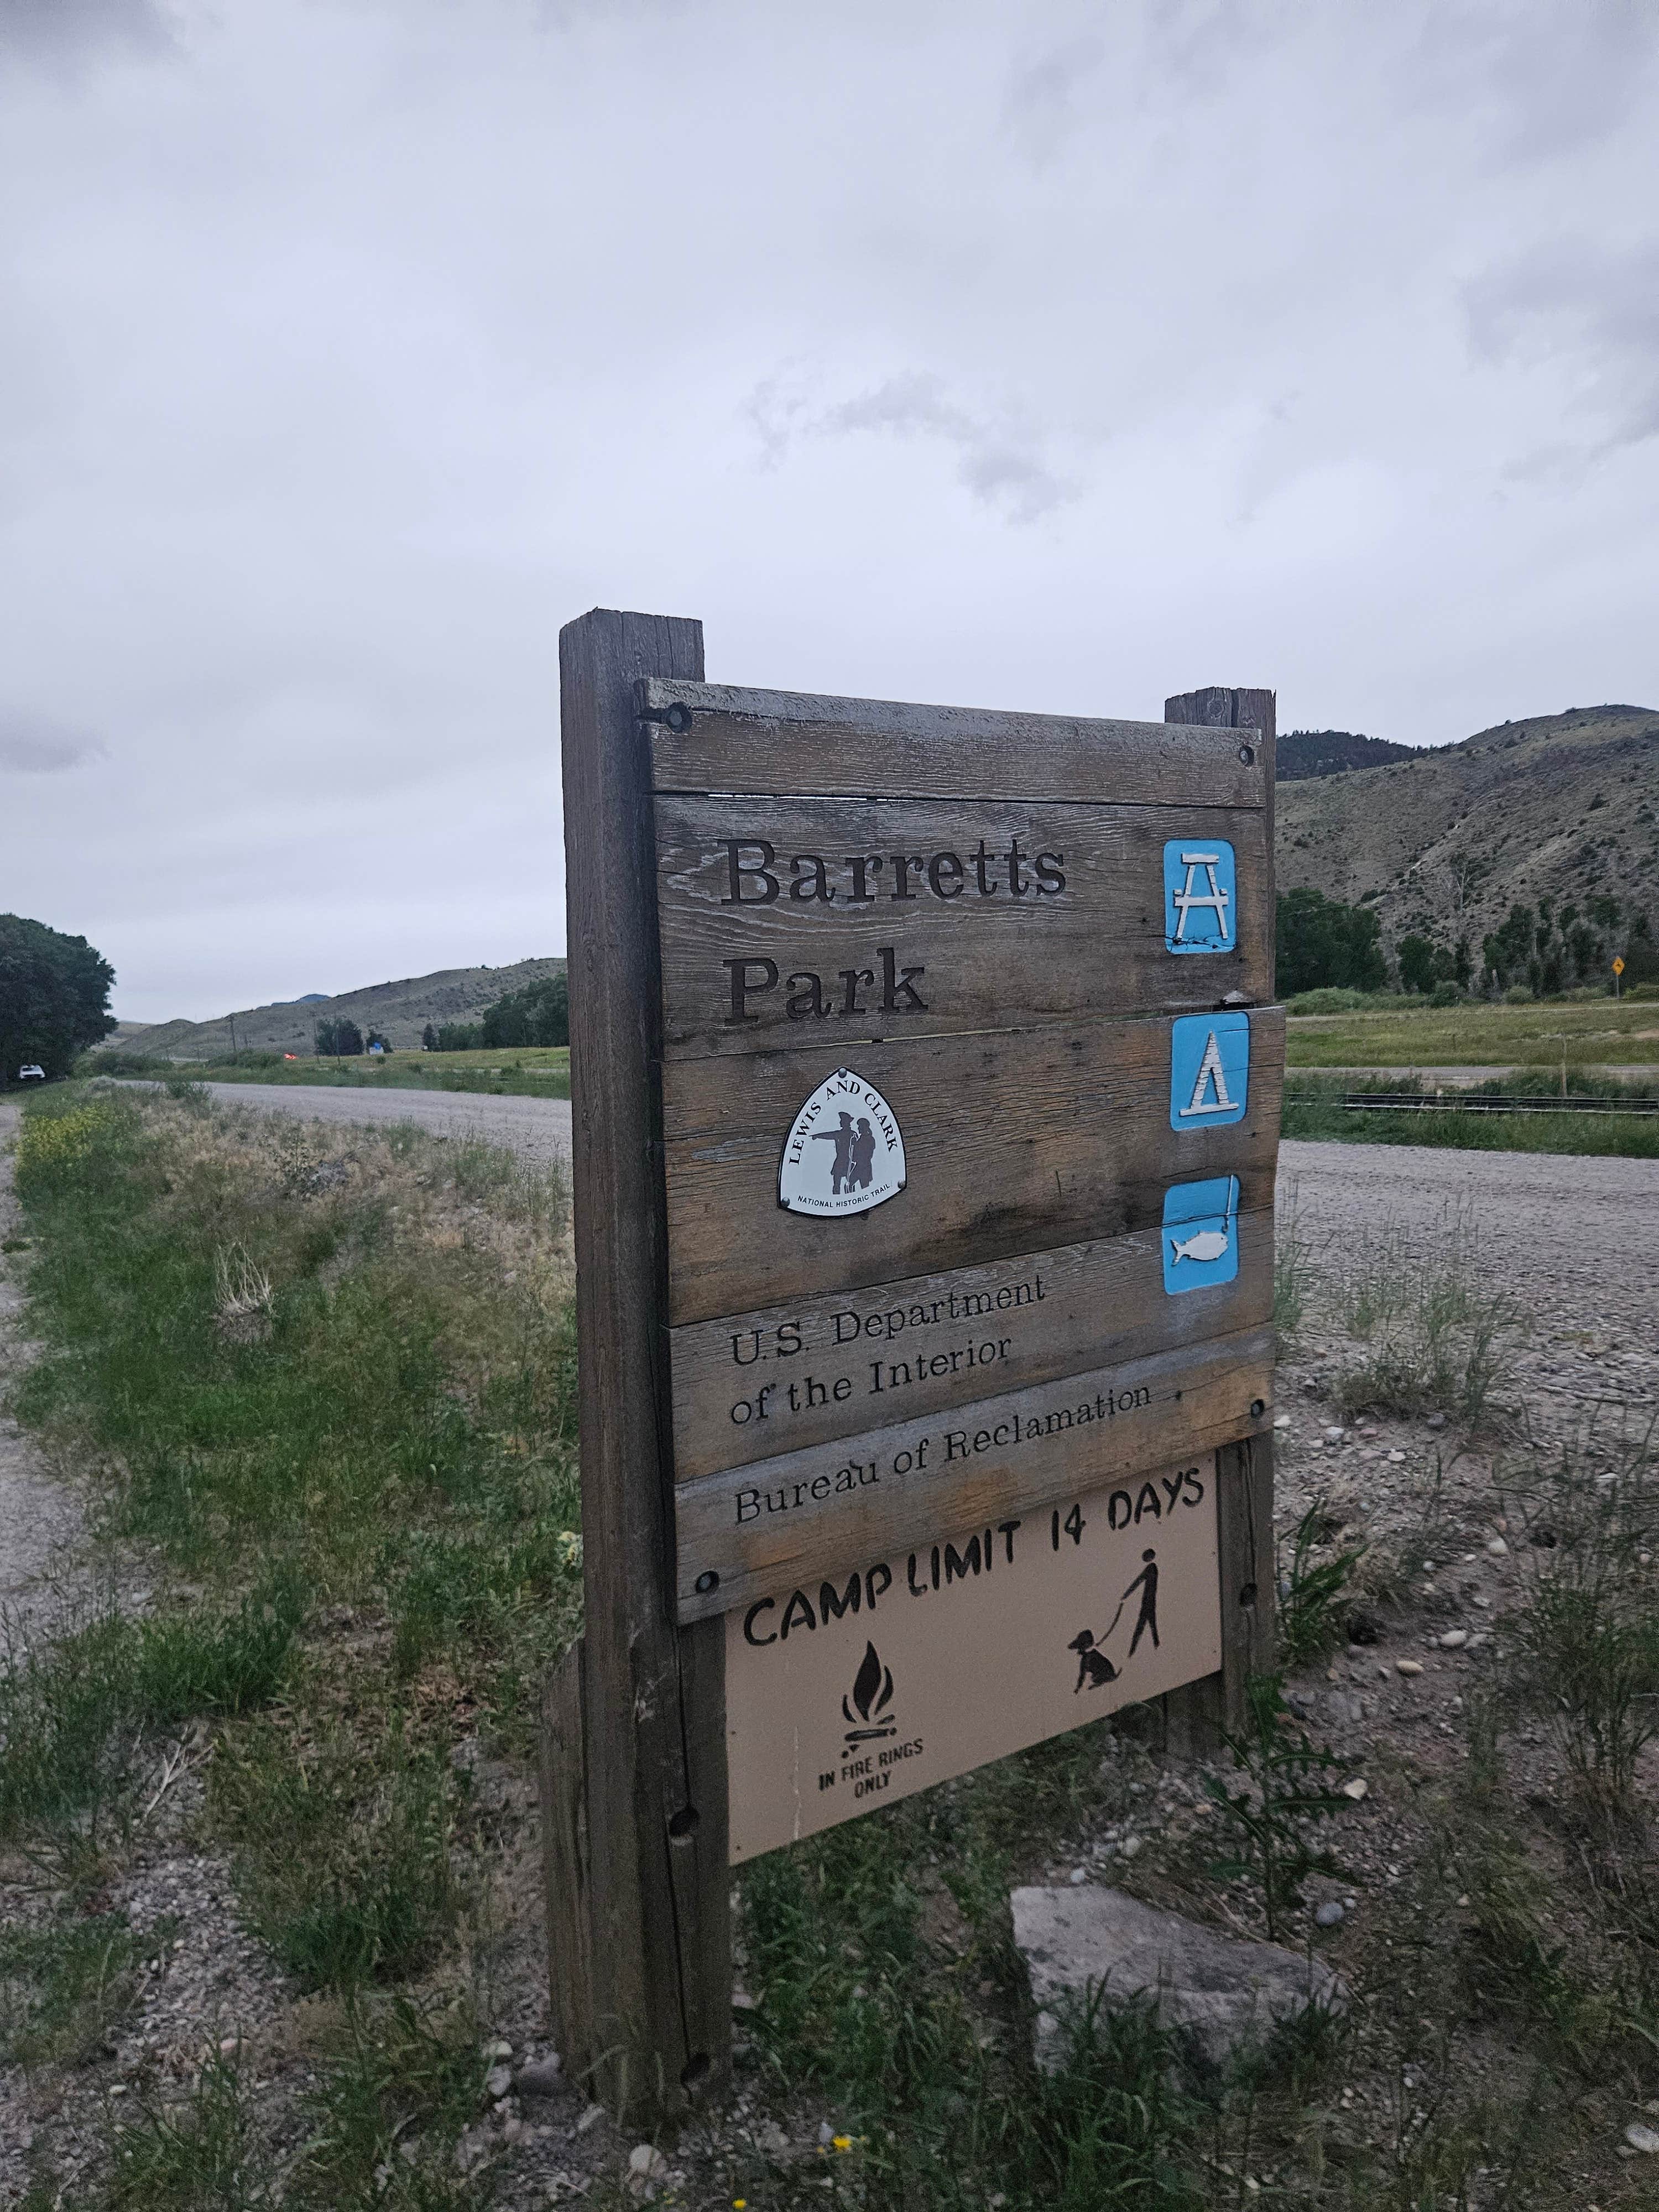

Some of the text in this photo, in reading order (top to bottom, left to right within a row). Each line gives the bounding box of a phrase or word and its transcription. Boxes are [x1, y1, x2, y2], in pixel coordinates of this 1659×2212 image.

[717, 838, 1066, 906] Barretts
[722, 947, 928, 1026] Park
[789, 1080, 898, 1166] LEWIS AND CLARK
[797, 1183, 890, 1208] NATIONAL HISTORIC TRAIL
[730, 1275, 1045, 1366] U.S. Department
[731, 1338, 1011, 1424] of the Interior
[735, 1386, 1151, 1524] Bureau of Reclamation
[744, 1467, 1204, 1646] CAMP LIMIT 14 DAYS
[818, 1738, 924, 1791] IN FIRE RINGS
[854, 1770, 892, 1799] ONLY
